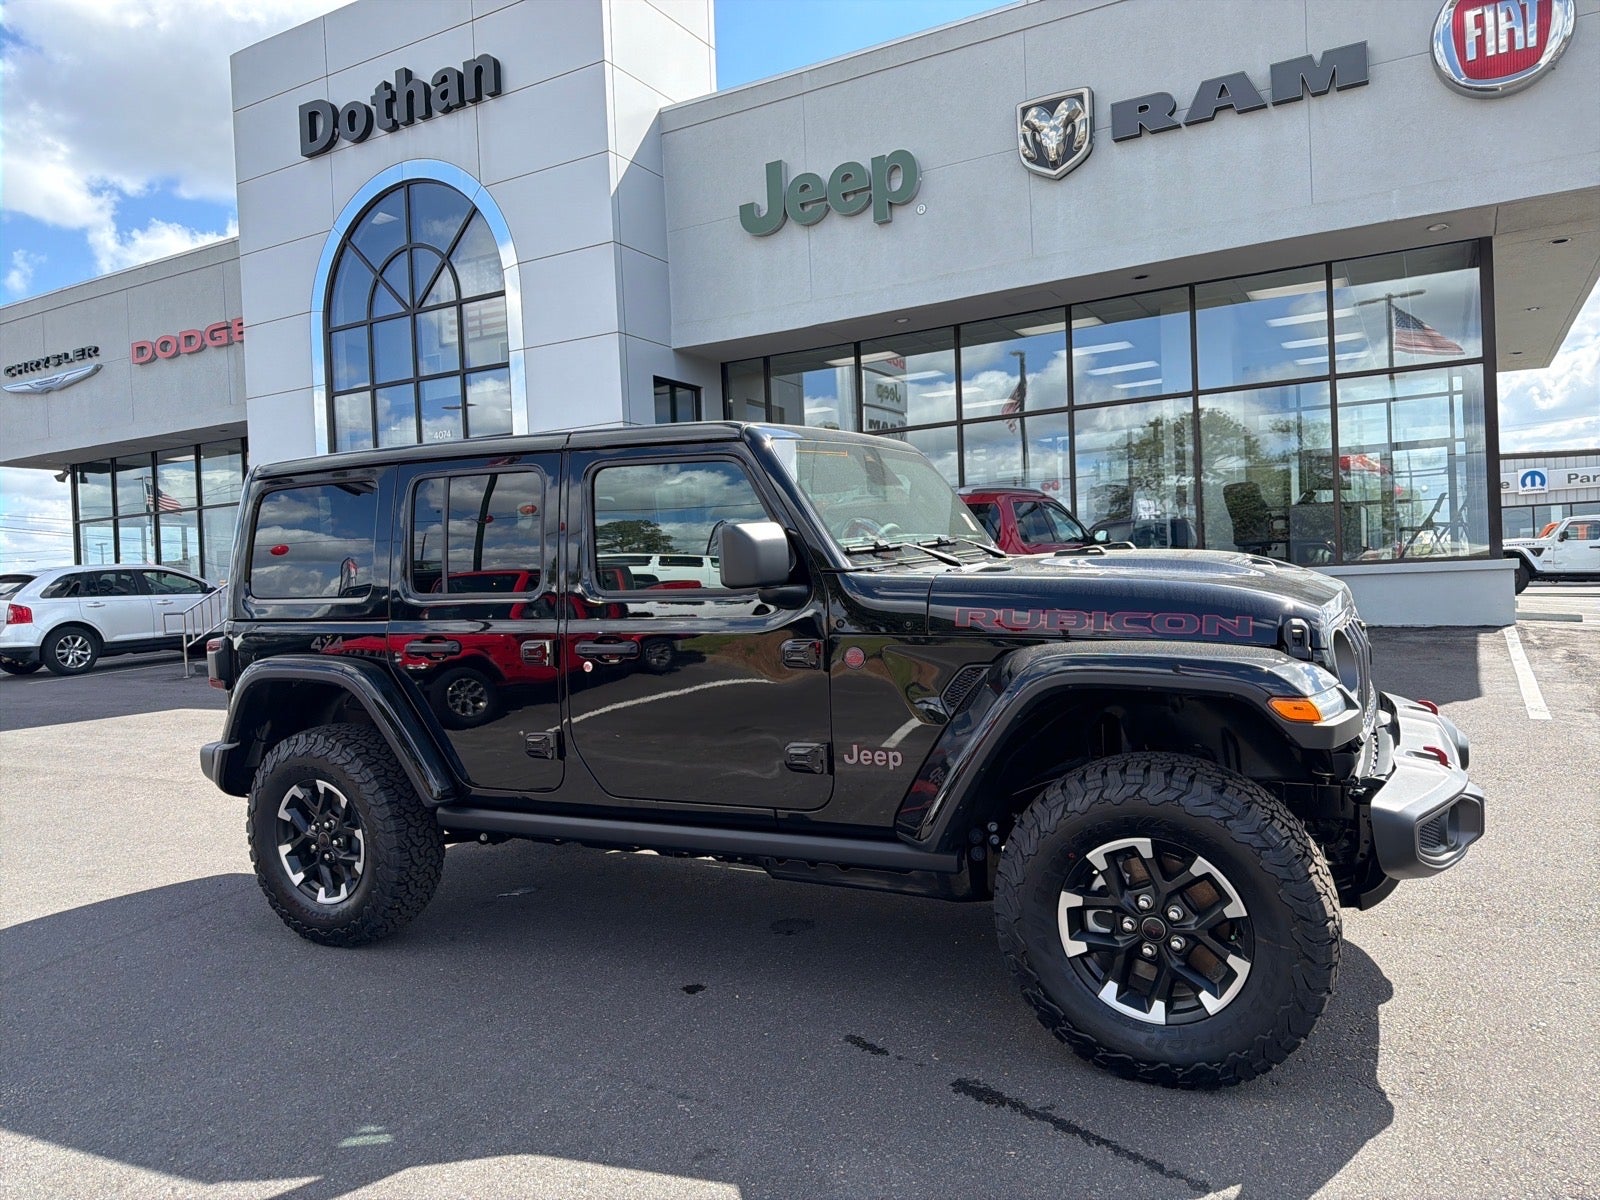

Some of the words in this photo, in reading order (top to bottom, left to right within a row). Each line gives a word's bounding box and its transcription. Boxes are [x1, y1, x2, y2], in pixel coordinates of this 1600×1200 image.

[1464, 0, 1540, 61] FIAT
[299, 54, 501, 158] Dothan
[1111, 40, 1369, 142] RAM
[739, 149, 921, 237] Jeep
[4, 346, 100, 377] CHRYSLER
[954, 607, 1253, 637] RUBICON
[843, 744, 903, 770] Jeep
